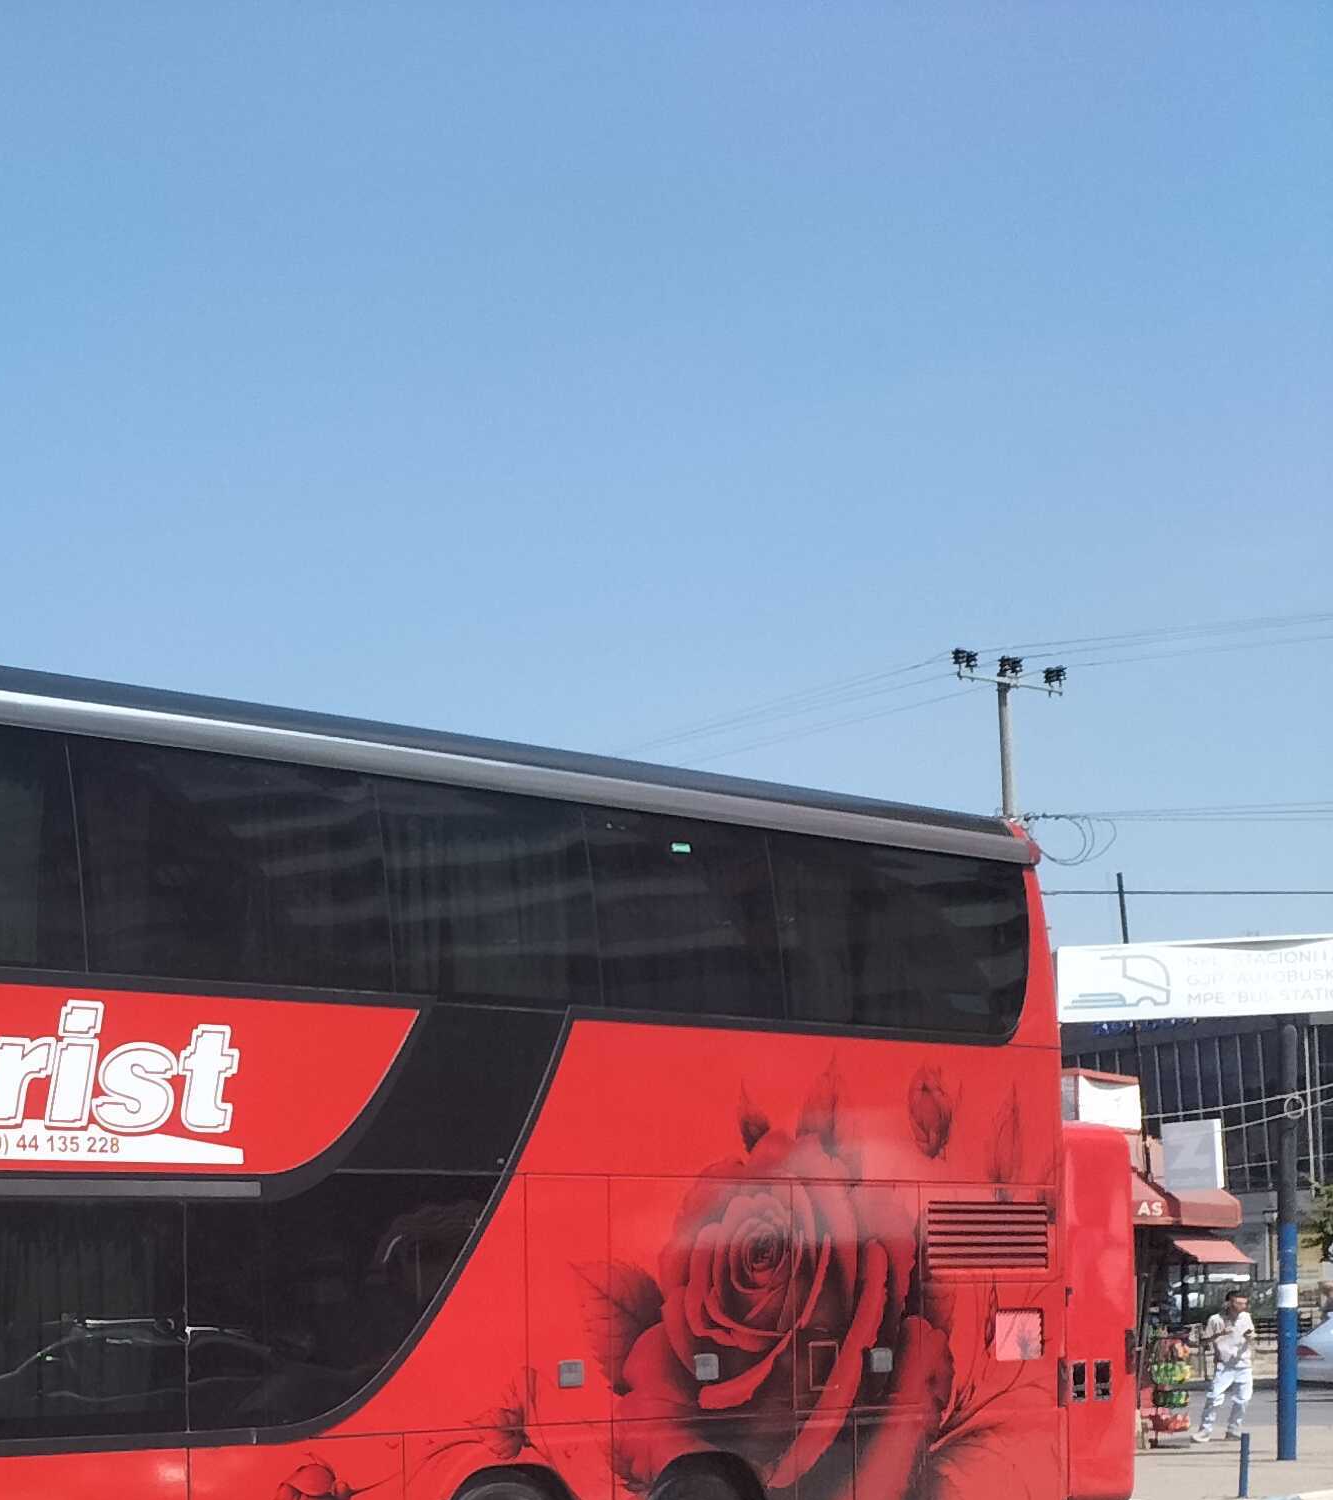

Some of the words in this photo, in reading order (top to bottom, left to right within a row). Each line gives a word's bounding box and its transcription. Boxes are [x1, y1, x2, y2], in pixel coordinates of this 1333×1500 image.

[16, 1135, 39, 1151] 44
[47, 1136, 80, 1153] 135
[86, 1137, 120, 1154] 228
[1137, 1201, 1164, 1217] AS
